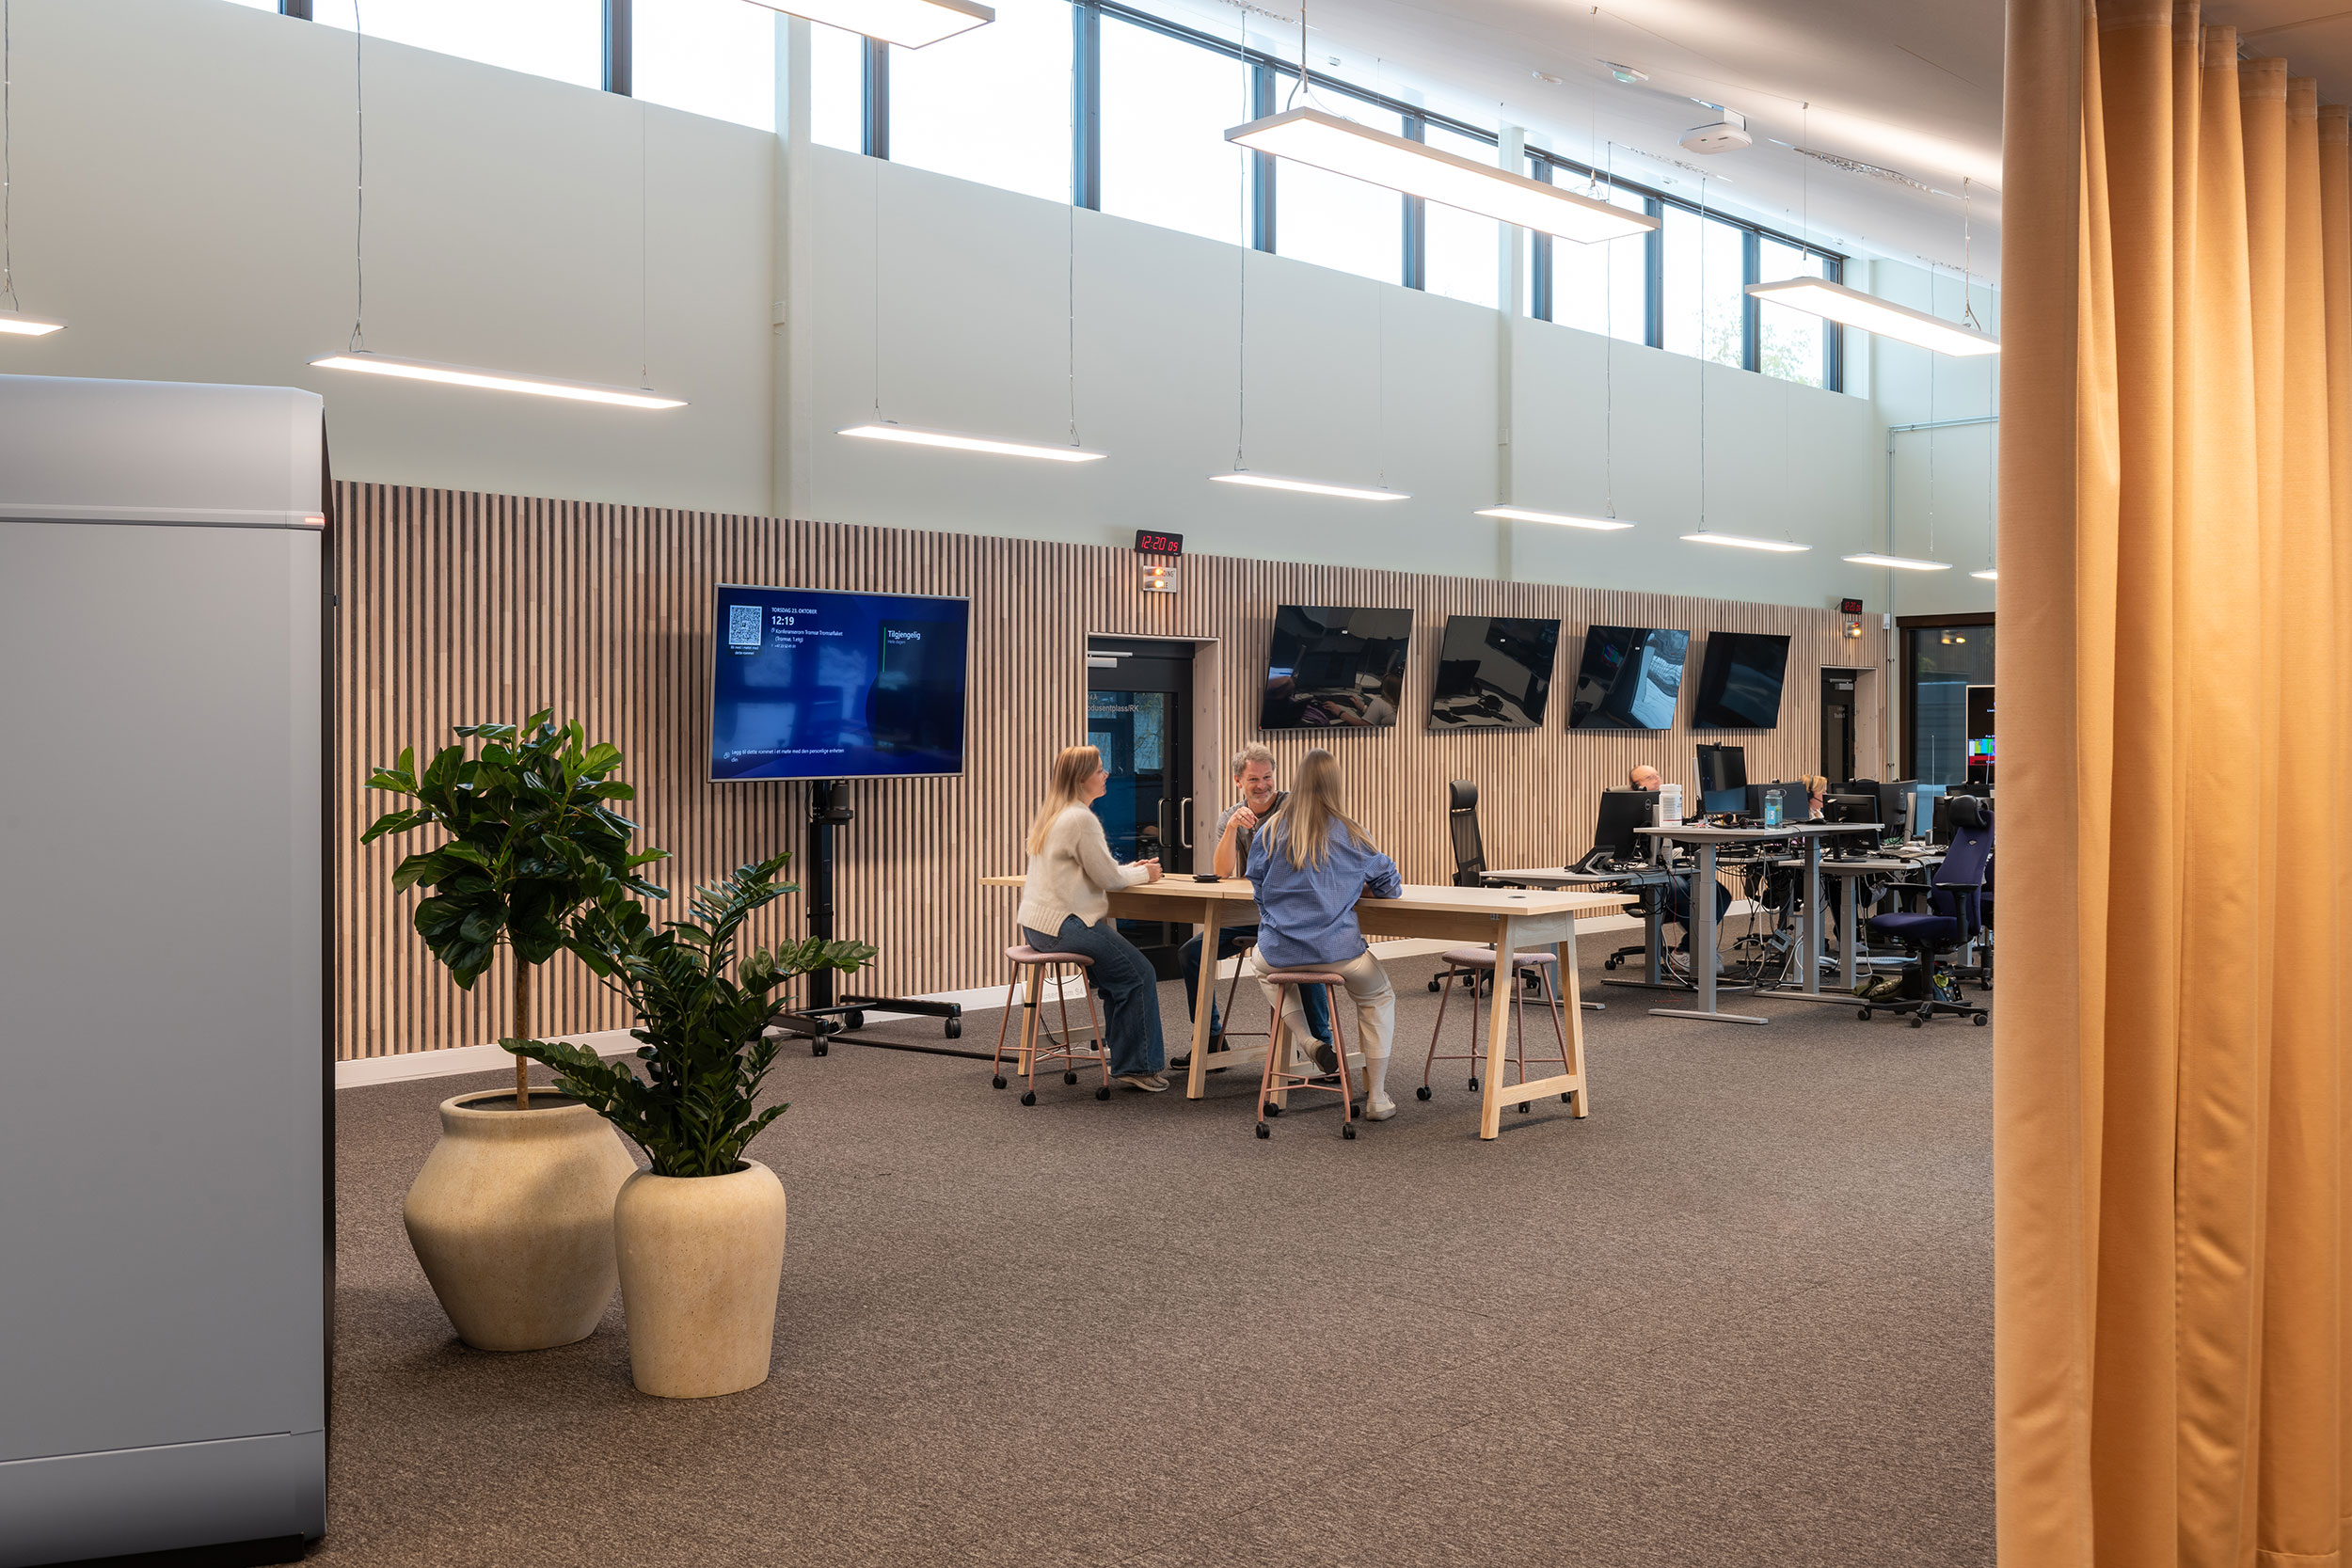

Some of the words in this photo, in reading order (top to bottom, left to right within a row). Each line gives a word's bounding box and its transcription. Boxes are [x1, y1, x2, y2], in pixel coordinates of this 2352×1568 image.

[1141, 535, 1167, 551] 12:20
[1168, 541, 1179, 552] 09
[771, 616, 795, 626] 12:19
[888, 630, 921, 640] Tilgjengelig
